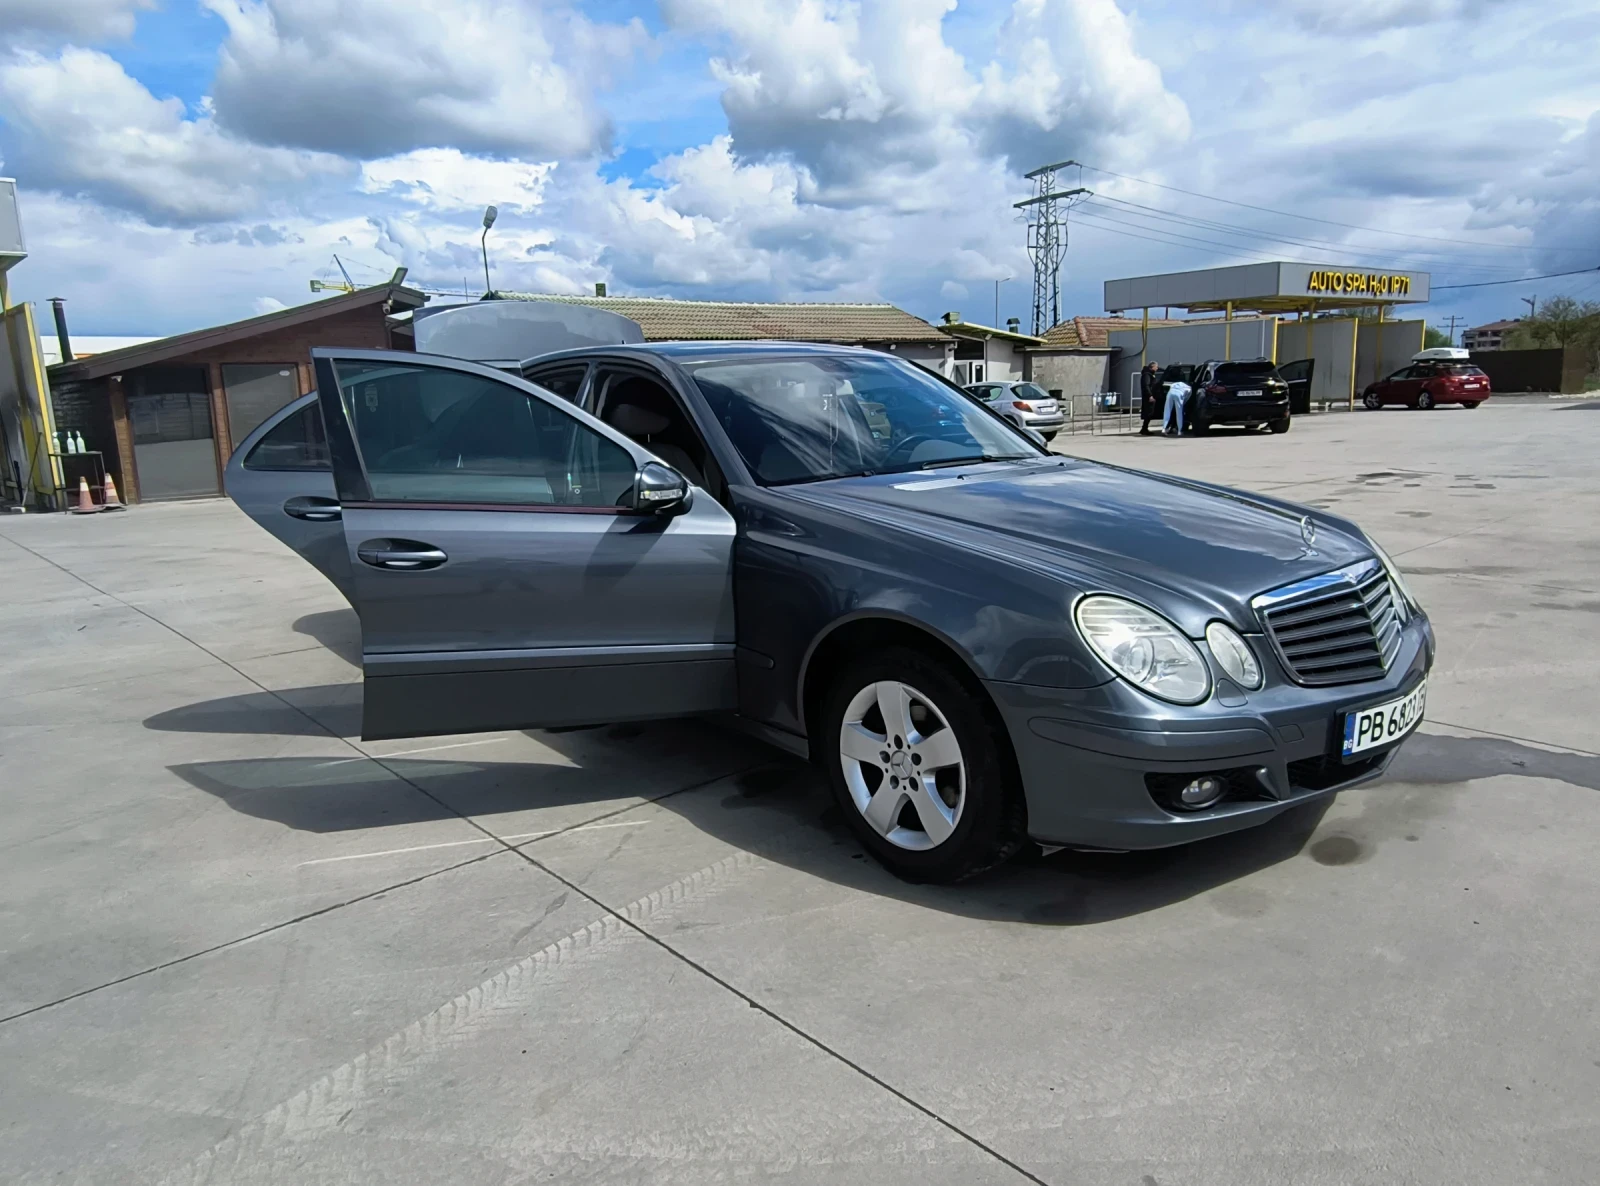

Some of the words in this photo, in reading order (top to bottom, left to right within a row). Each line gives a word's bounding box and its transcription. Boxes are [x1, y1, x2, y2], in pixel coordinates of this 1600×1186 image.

[1310, 271, 1343, 291] AUTO
[1346, 273, 1366, 292] SPA
[1391, 276, 1410, 294] IP71
[1357, 711, 1384, 747] PB
[1343, 739, 1353, 750] BG
